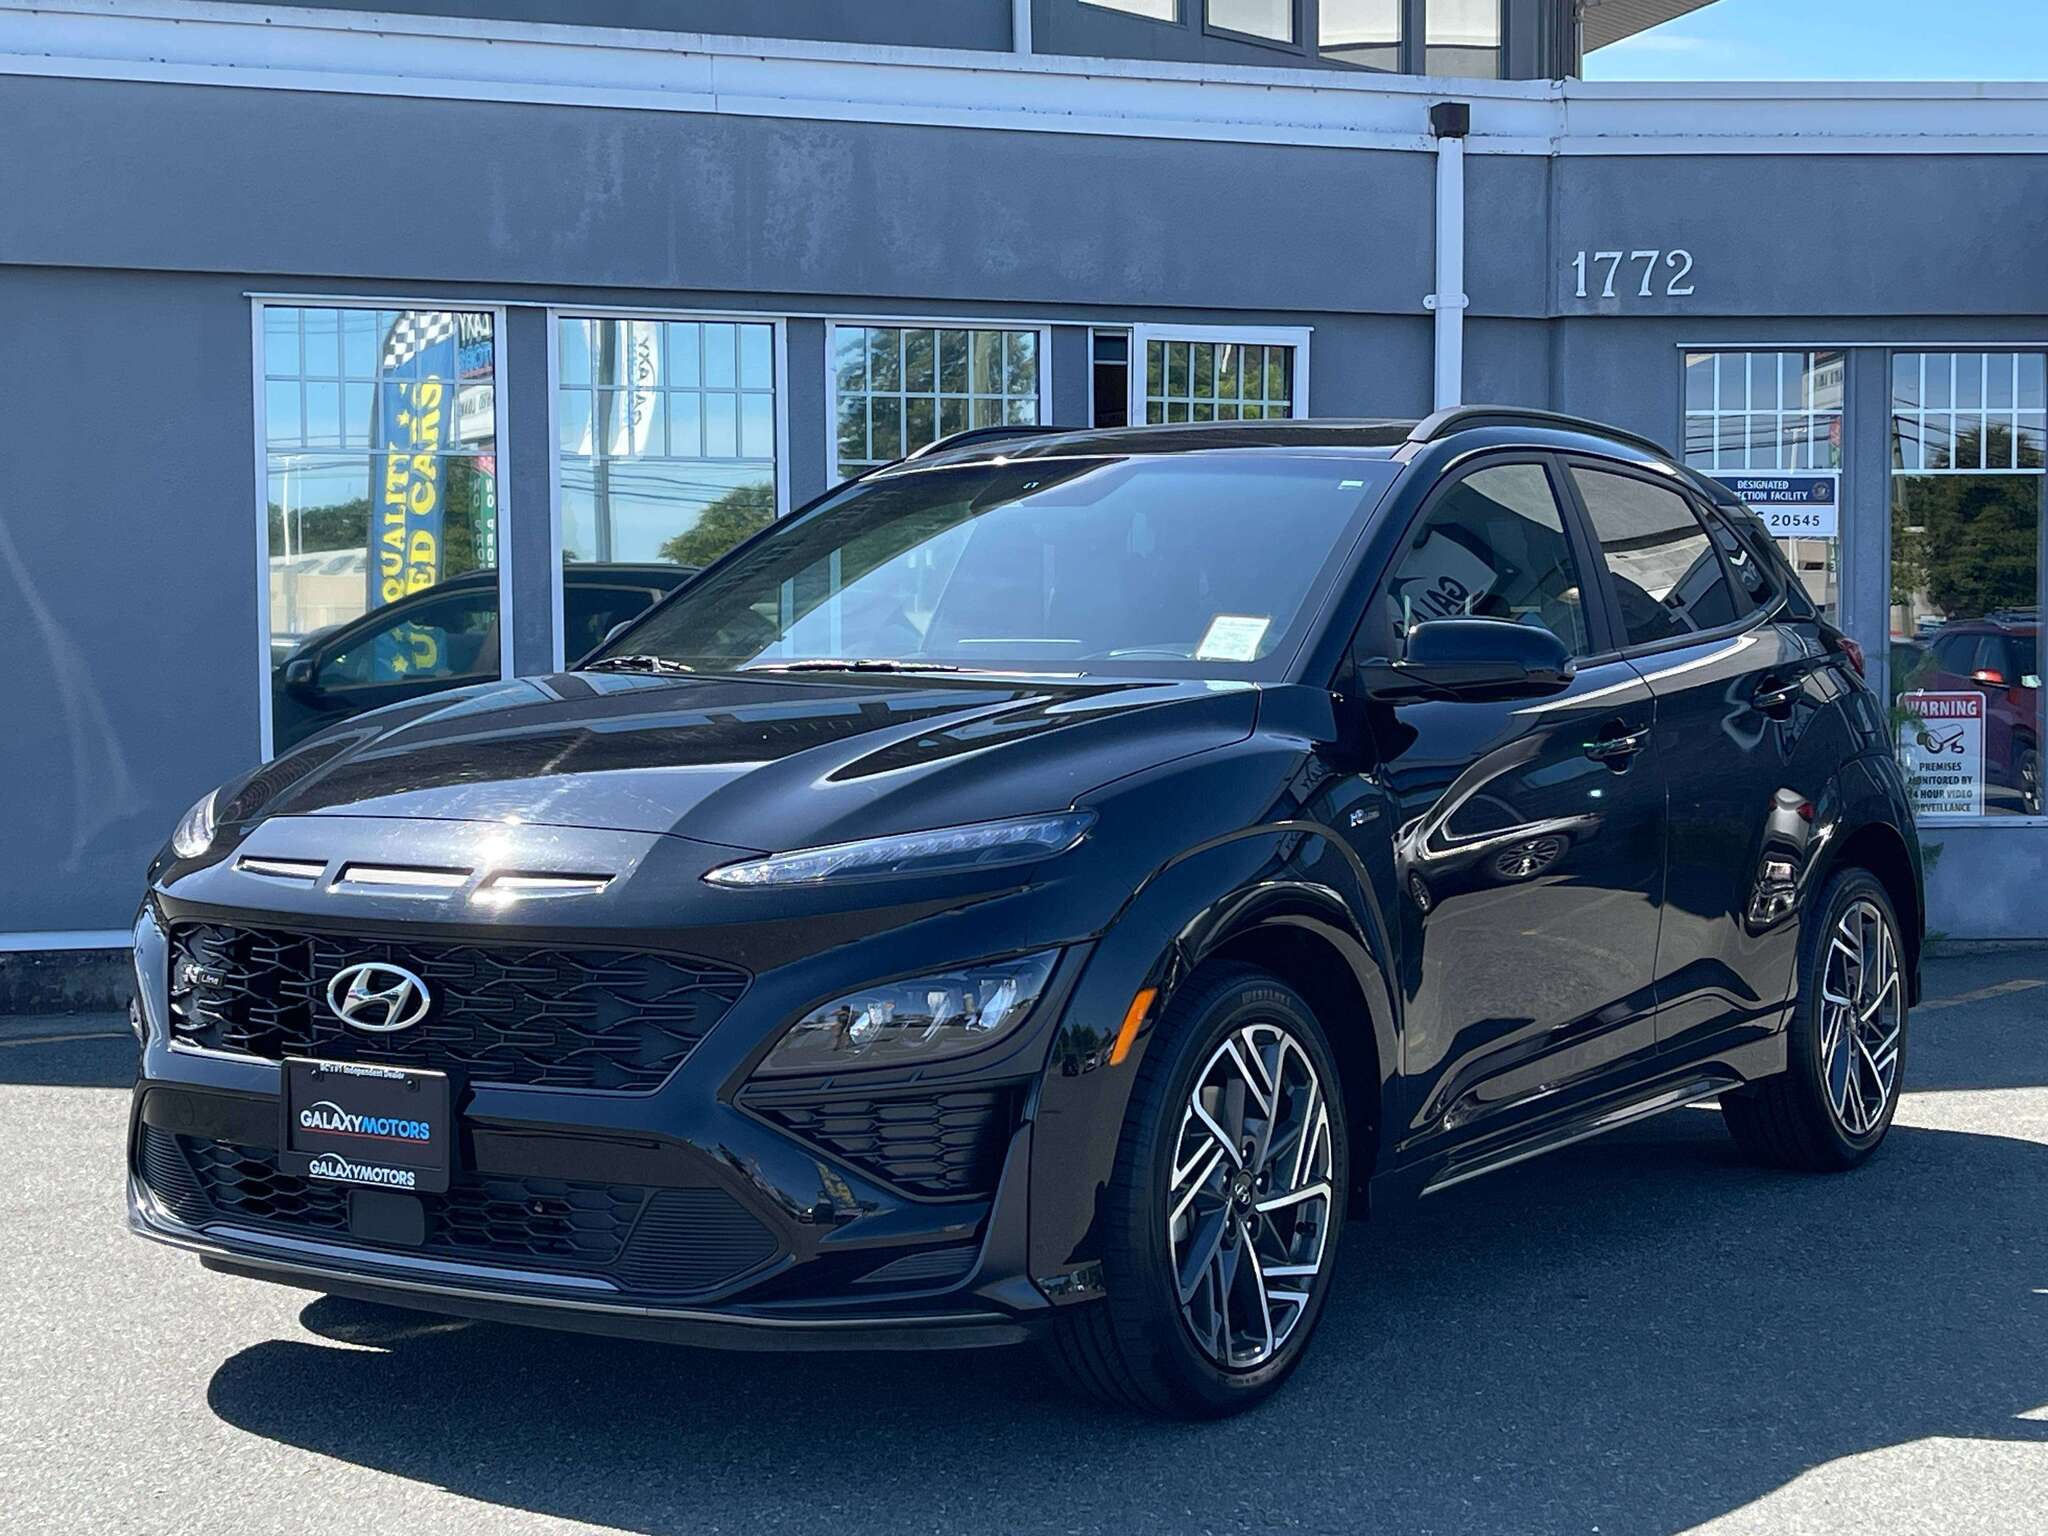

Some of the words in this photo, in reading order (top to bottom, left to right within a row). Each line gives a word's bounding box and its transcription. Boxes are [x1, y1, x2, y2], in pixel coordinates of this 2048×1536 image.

[1571, 249, 1695, 297] 1772
[409, 374, 444, 515] CARS
[1737, 480, 1789, 490] DESIGNATED
[1736, 491, 1768, 501] ECTION
[1770, 491, 1808, 501] FACILITY
[382, 441, 410, 603] QUALITY
[1770, 514, 1821, 527] 20545
[405, 529, 438, 669] UED
[1905, 700, 1977, 717] WARNING
[1919, 762, 1962, 771] PREMISES
[1961, 775, 1973, 785] BY
[1920, 789, 1944, 799] HOUR
[1946, 789, 1973, 799] VIDEO
